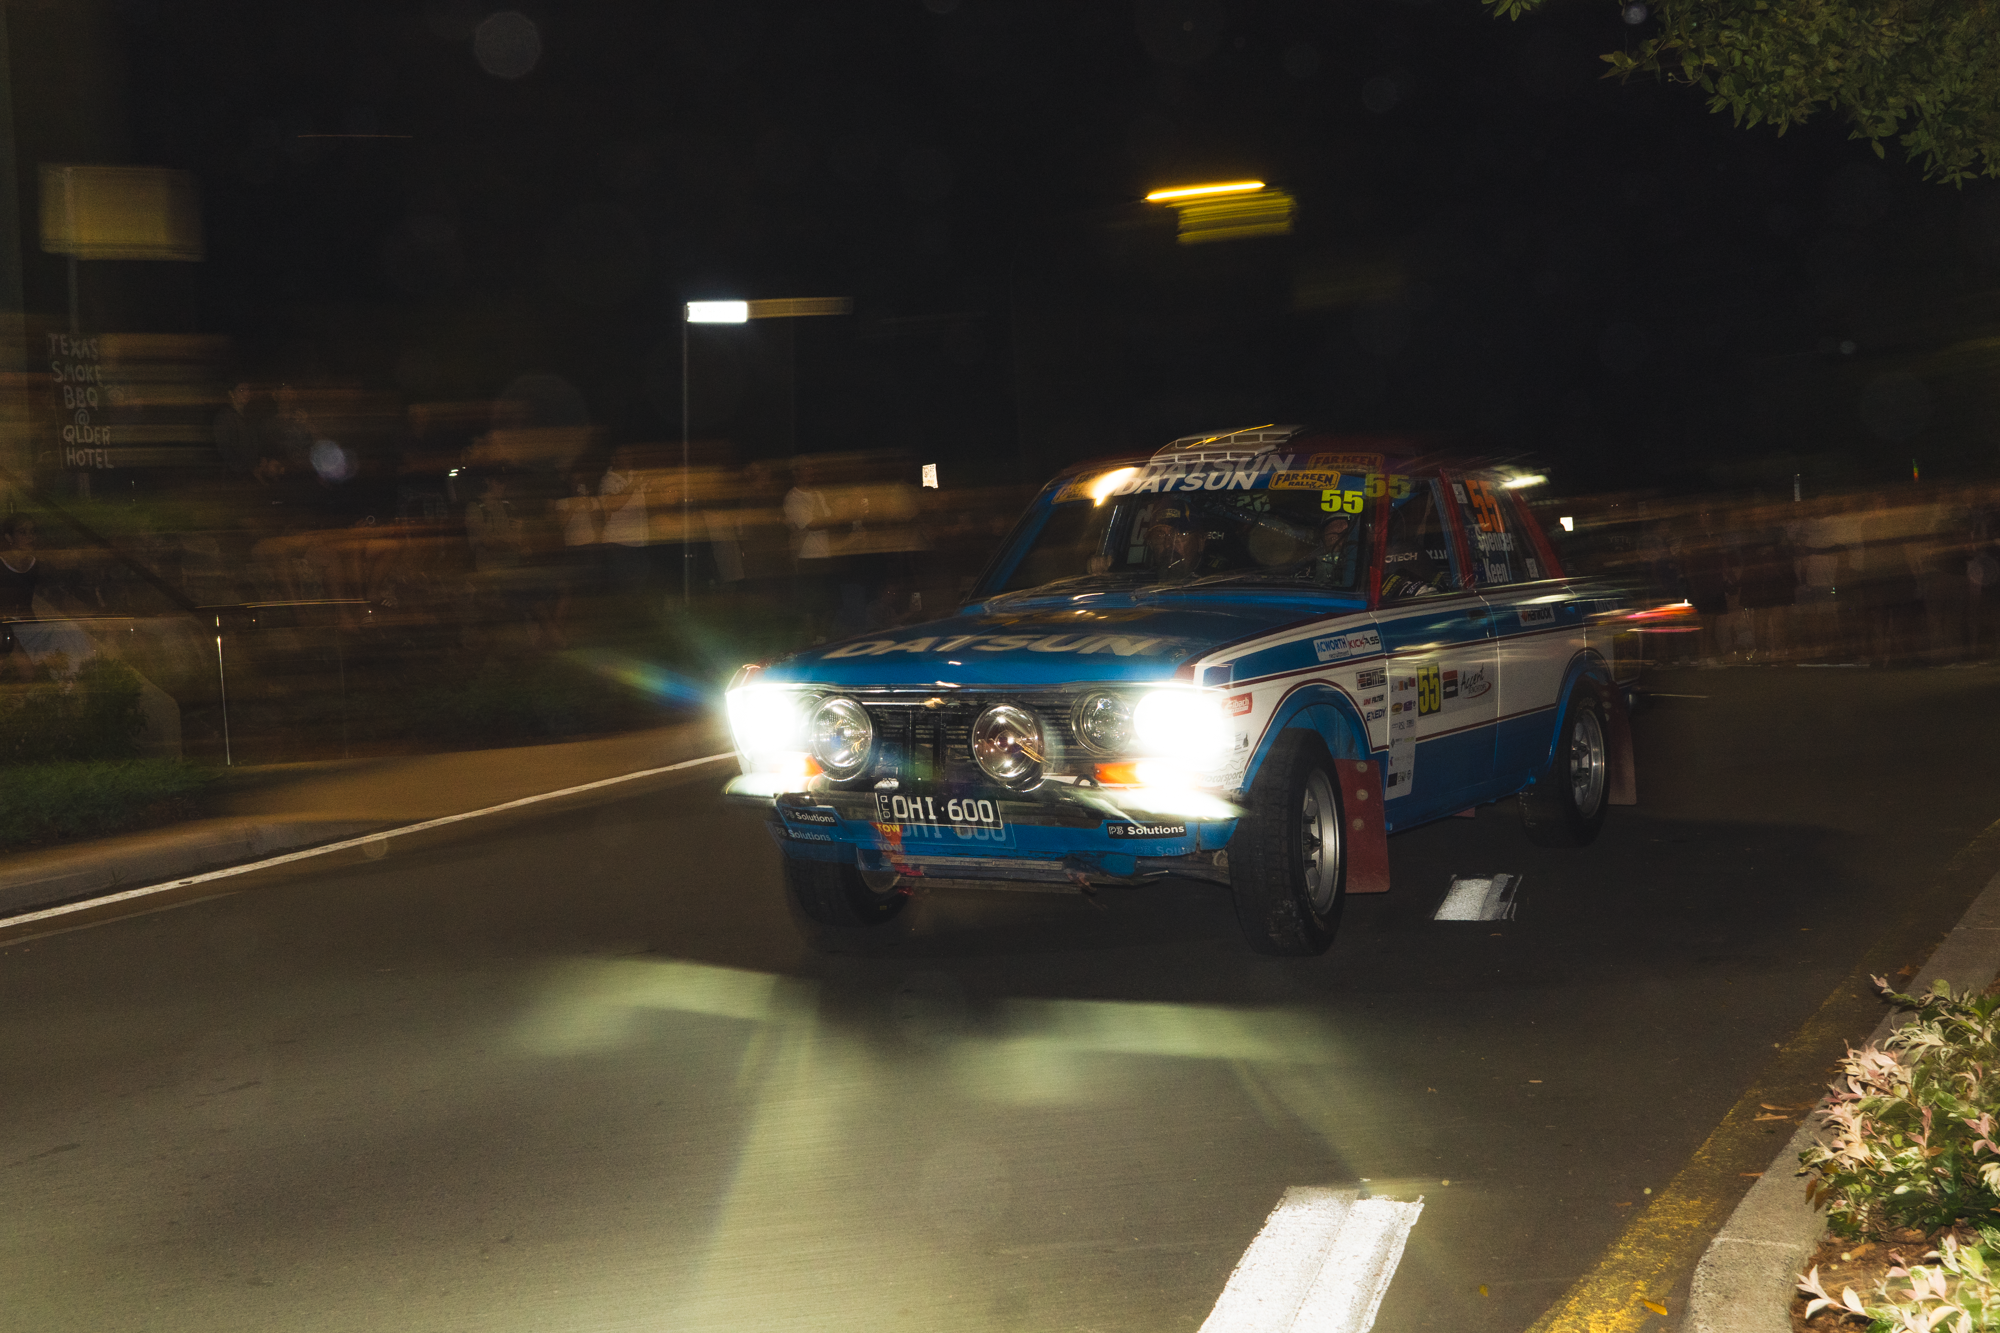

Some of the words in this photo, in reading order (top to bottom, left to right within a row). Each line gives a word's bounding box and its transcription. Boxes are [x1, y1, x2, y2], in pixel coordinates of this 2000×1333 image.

[48, 333, 99, 360] TEXAS
[52, 361, 103, 387] SMOKE
[63, 385, 98, 410] BBQ
[75, 408, 90, 425] @
[66, 447, 114, 469] HOTEL
[1112, 472, 1259, 497] DATSUN
[1364, 473, 1411, 499] 55
[1321, 489, 1364, 514] 55
[1465, 480, 1506, 533] 55
[1475, 524, 1514, 557] Spencer
[1483, 557, 1509, 583] Keen
[820, 633, 1166, 661] DATSUN
[1316, 638, 1347, 653] ACWORTH
[1418, 666, 1440, 713] 55
[1461, 664, 1484, 692] Accent
[795, 811, 836, 823] Solutions
[876, 824, 901, 833] TOW
[1127, 825, 1185, 836] Solutions
